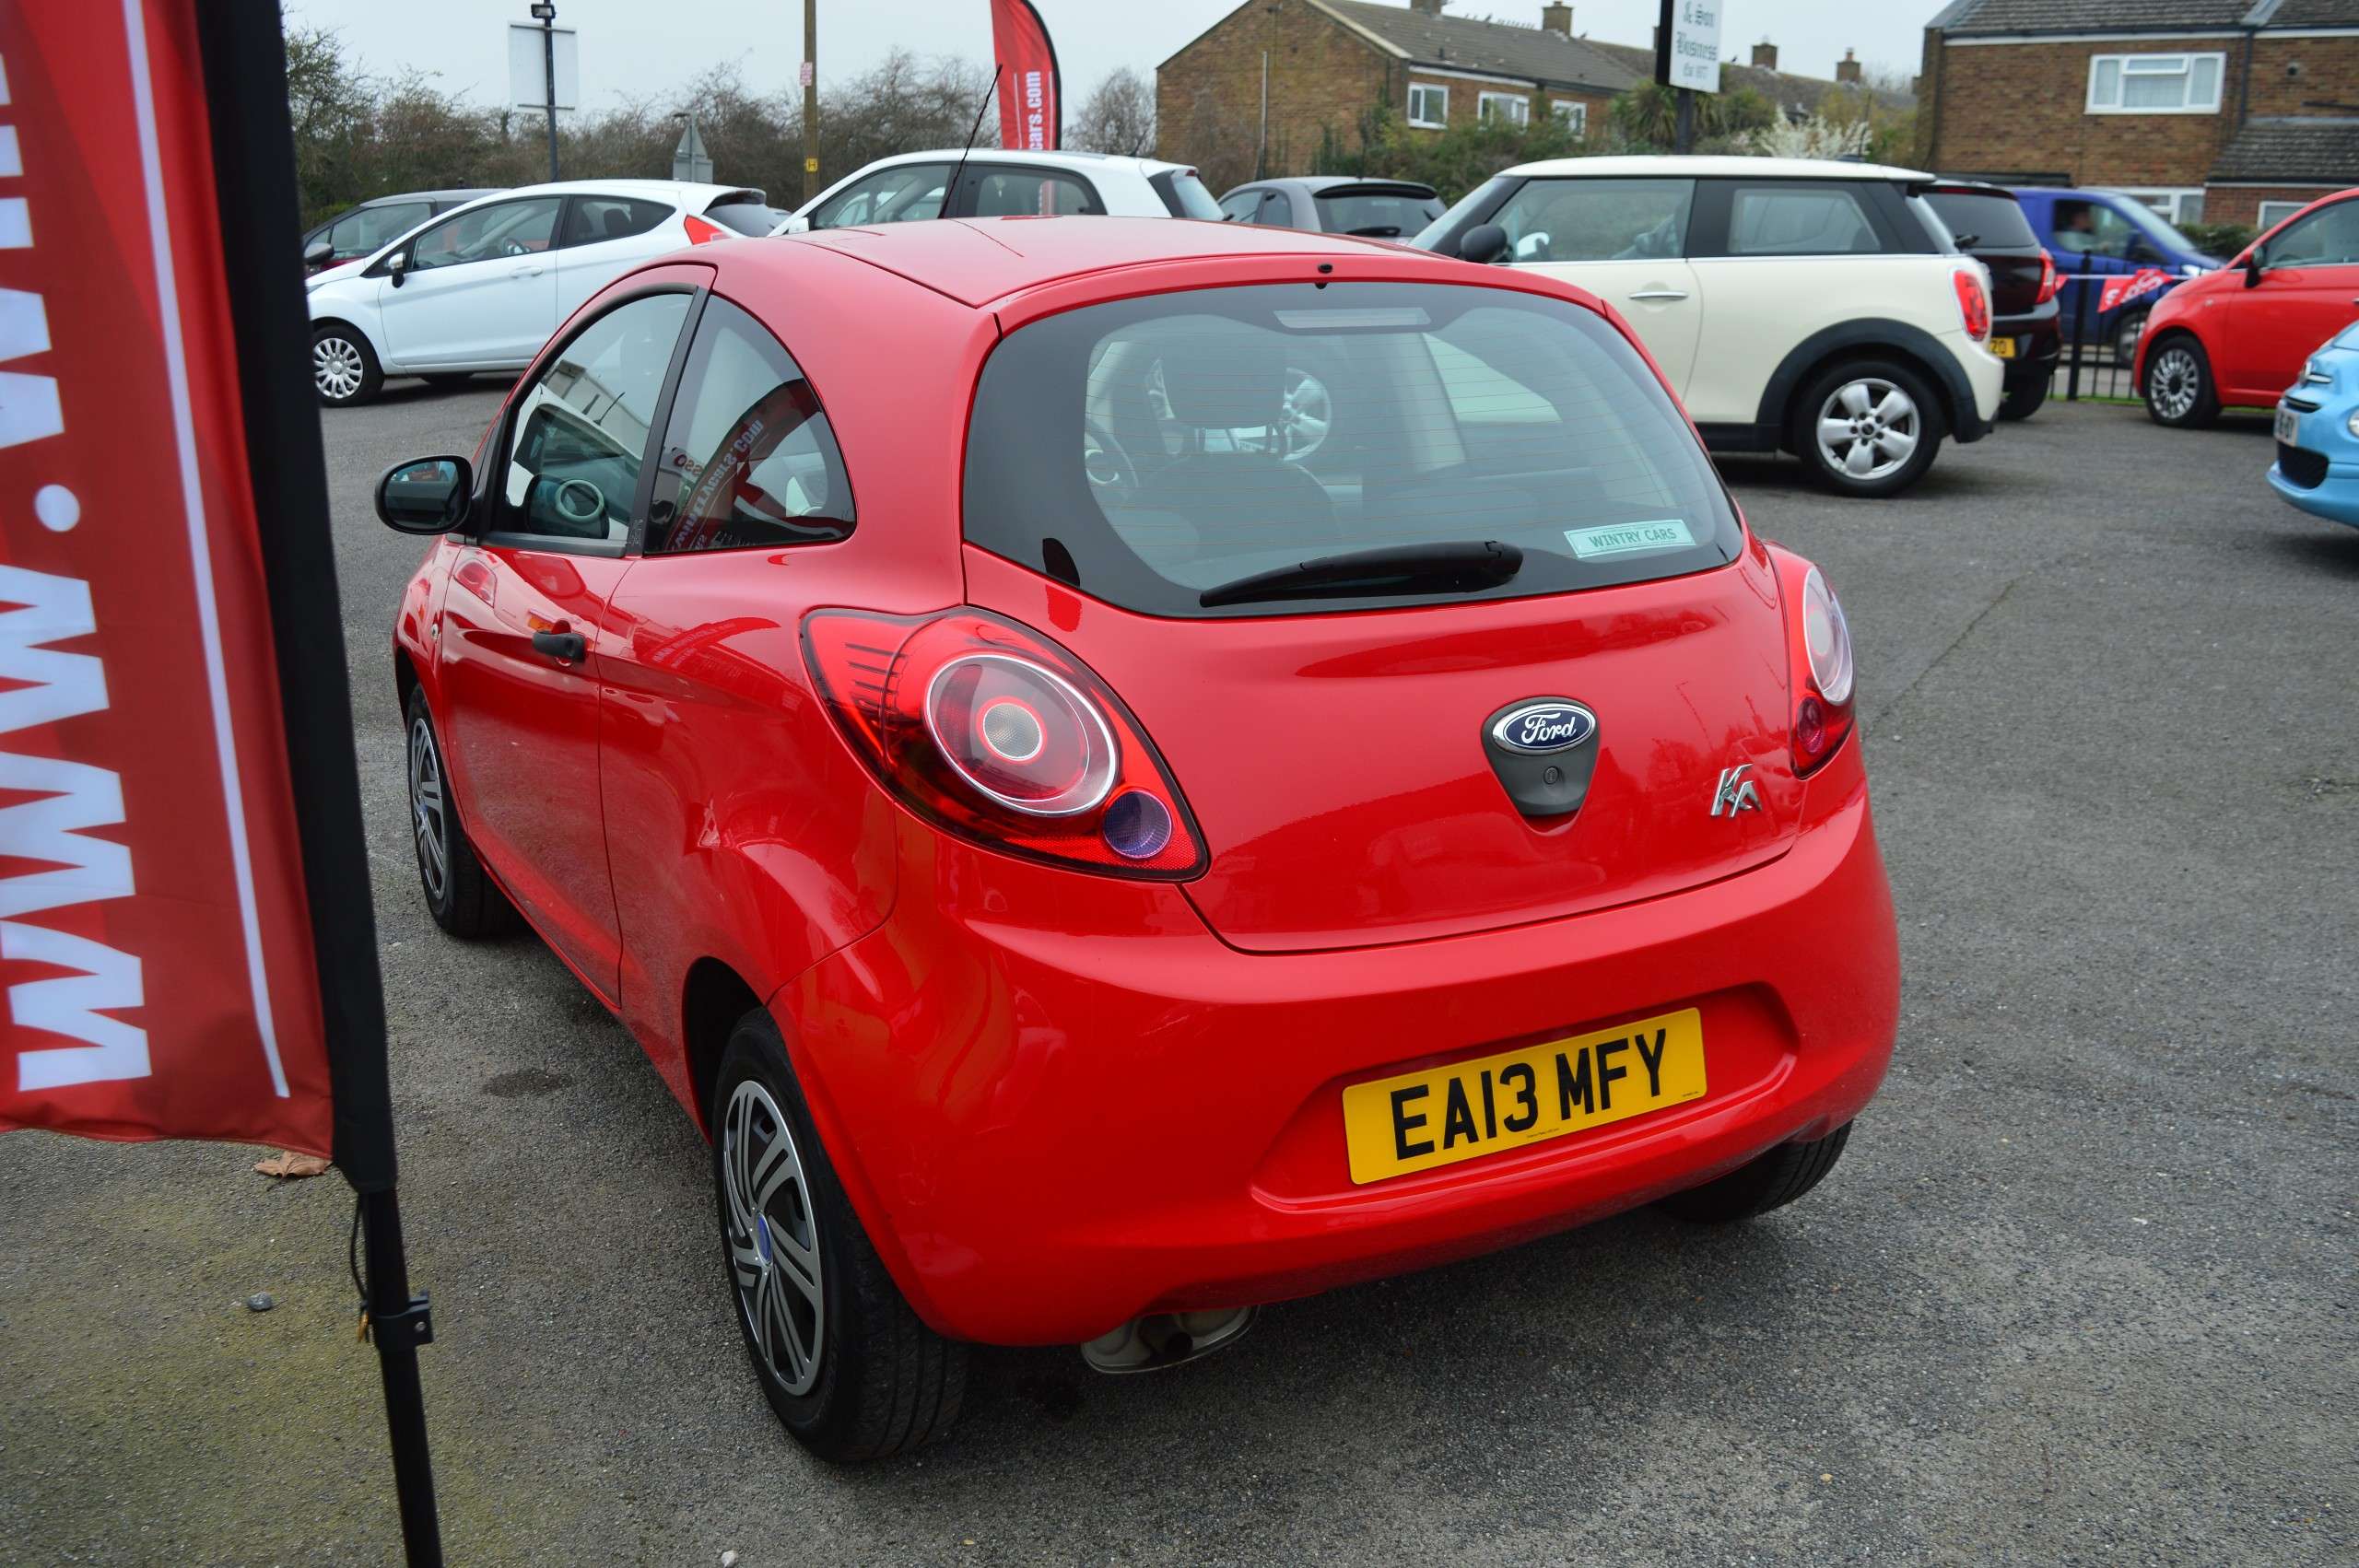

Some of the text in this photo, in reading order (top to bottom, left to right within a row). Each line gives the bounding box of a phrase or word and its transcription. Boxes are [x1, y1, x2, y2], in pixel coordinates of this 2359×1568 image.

[1589, 531, 1641, 547] WINTRY
[1644, 528, 1677, 542] CARS
[1520, 712, 1577, 744] Ford
[1391, 1028, 1666, 1161] EA13 MFY
